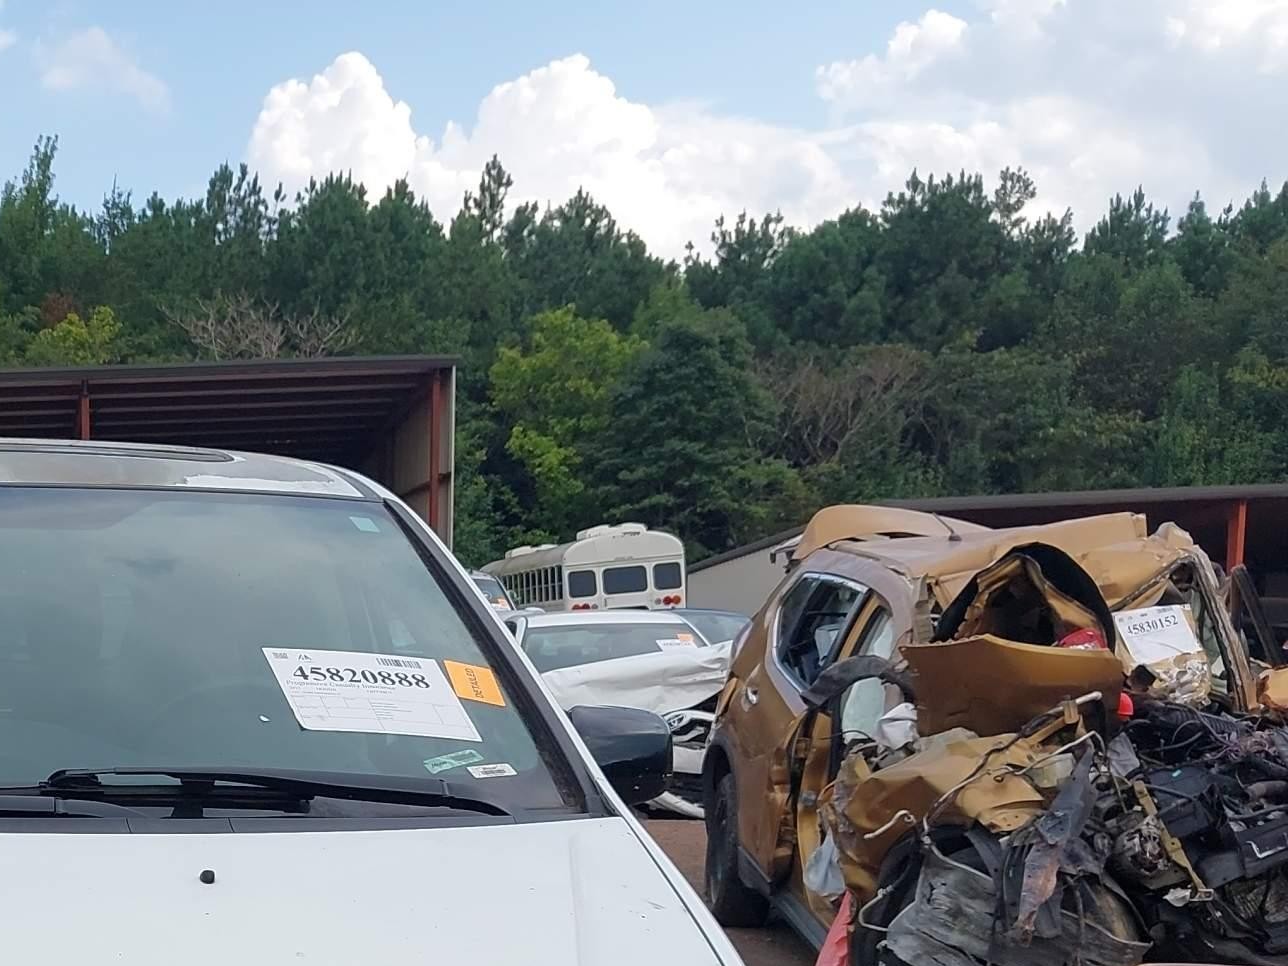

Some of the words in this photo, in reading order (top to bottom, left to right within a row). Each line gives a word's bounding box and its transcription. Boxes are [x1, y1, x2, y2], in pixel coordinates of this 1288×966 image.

[1127, 614, 1179, 635] 45830152
[292, 664, 431, 690] 45820888
[464, 667, 484, 699] DETAILED
